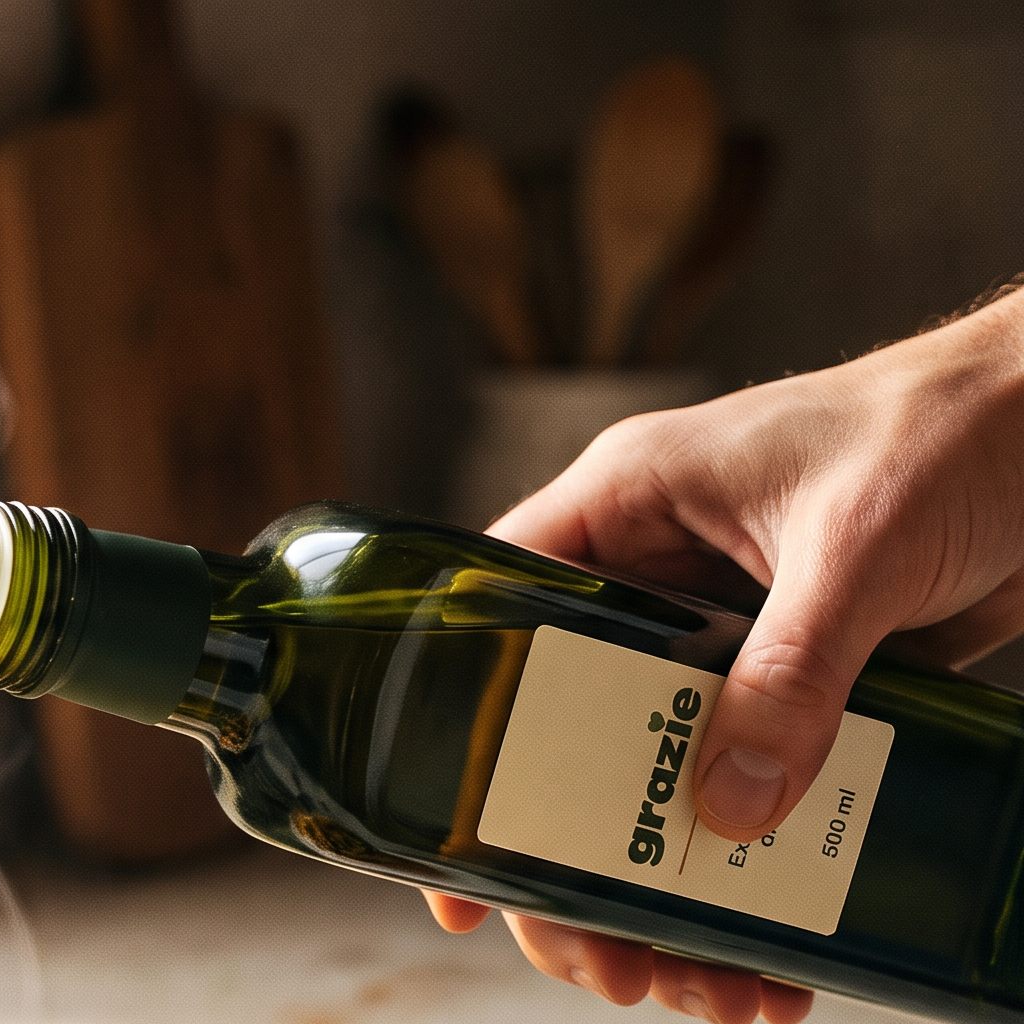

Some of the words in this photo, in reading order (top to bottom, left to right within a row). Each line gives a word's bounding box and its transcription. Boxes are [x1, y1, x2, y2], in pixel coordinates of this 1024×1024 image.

[628, 687, 702, 867] grazie
[822, 819, 846, 858] 500
[838, 788, 856, 815] ml
